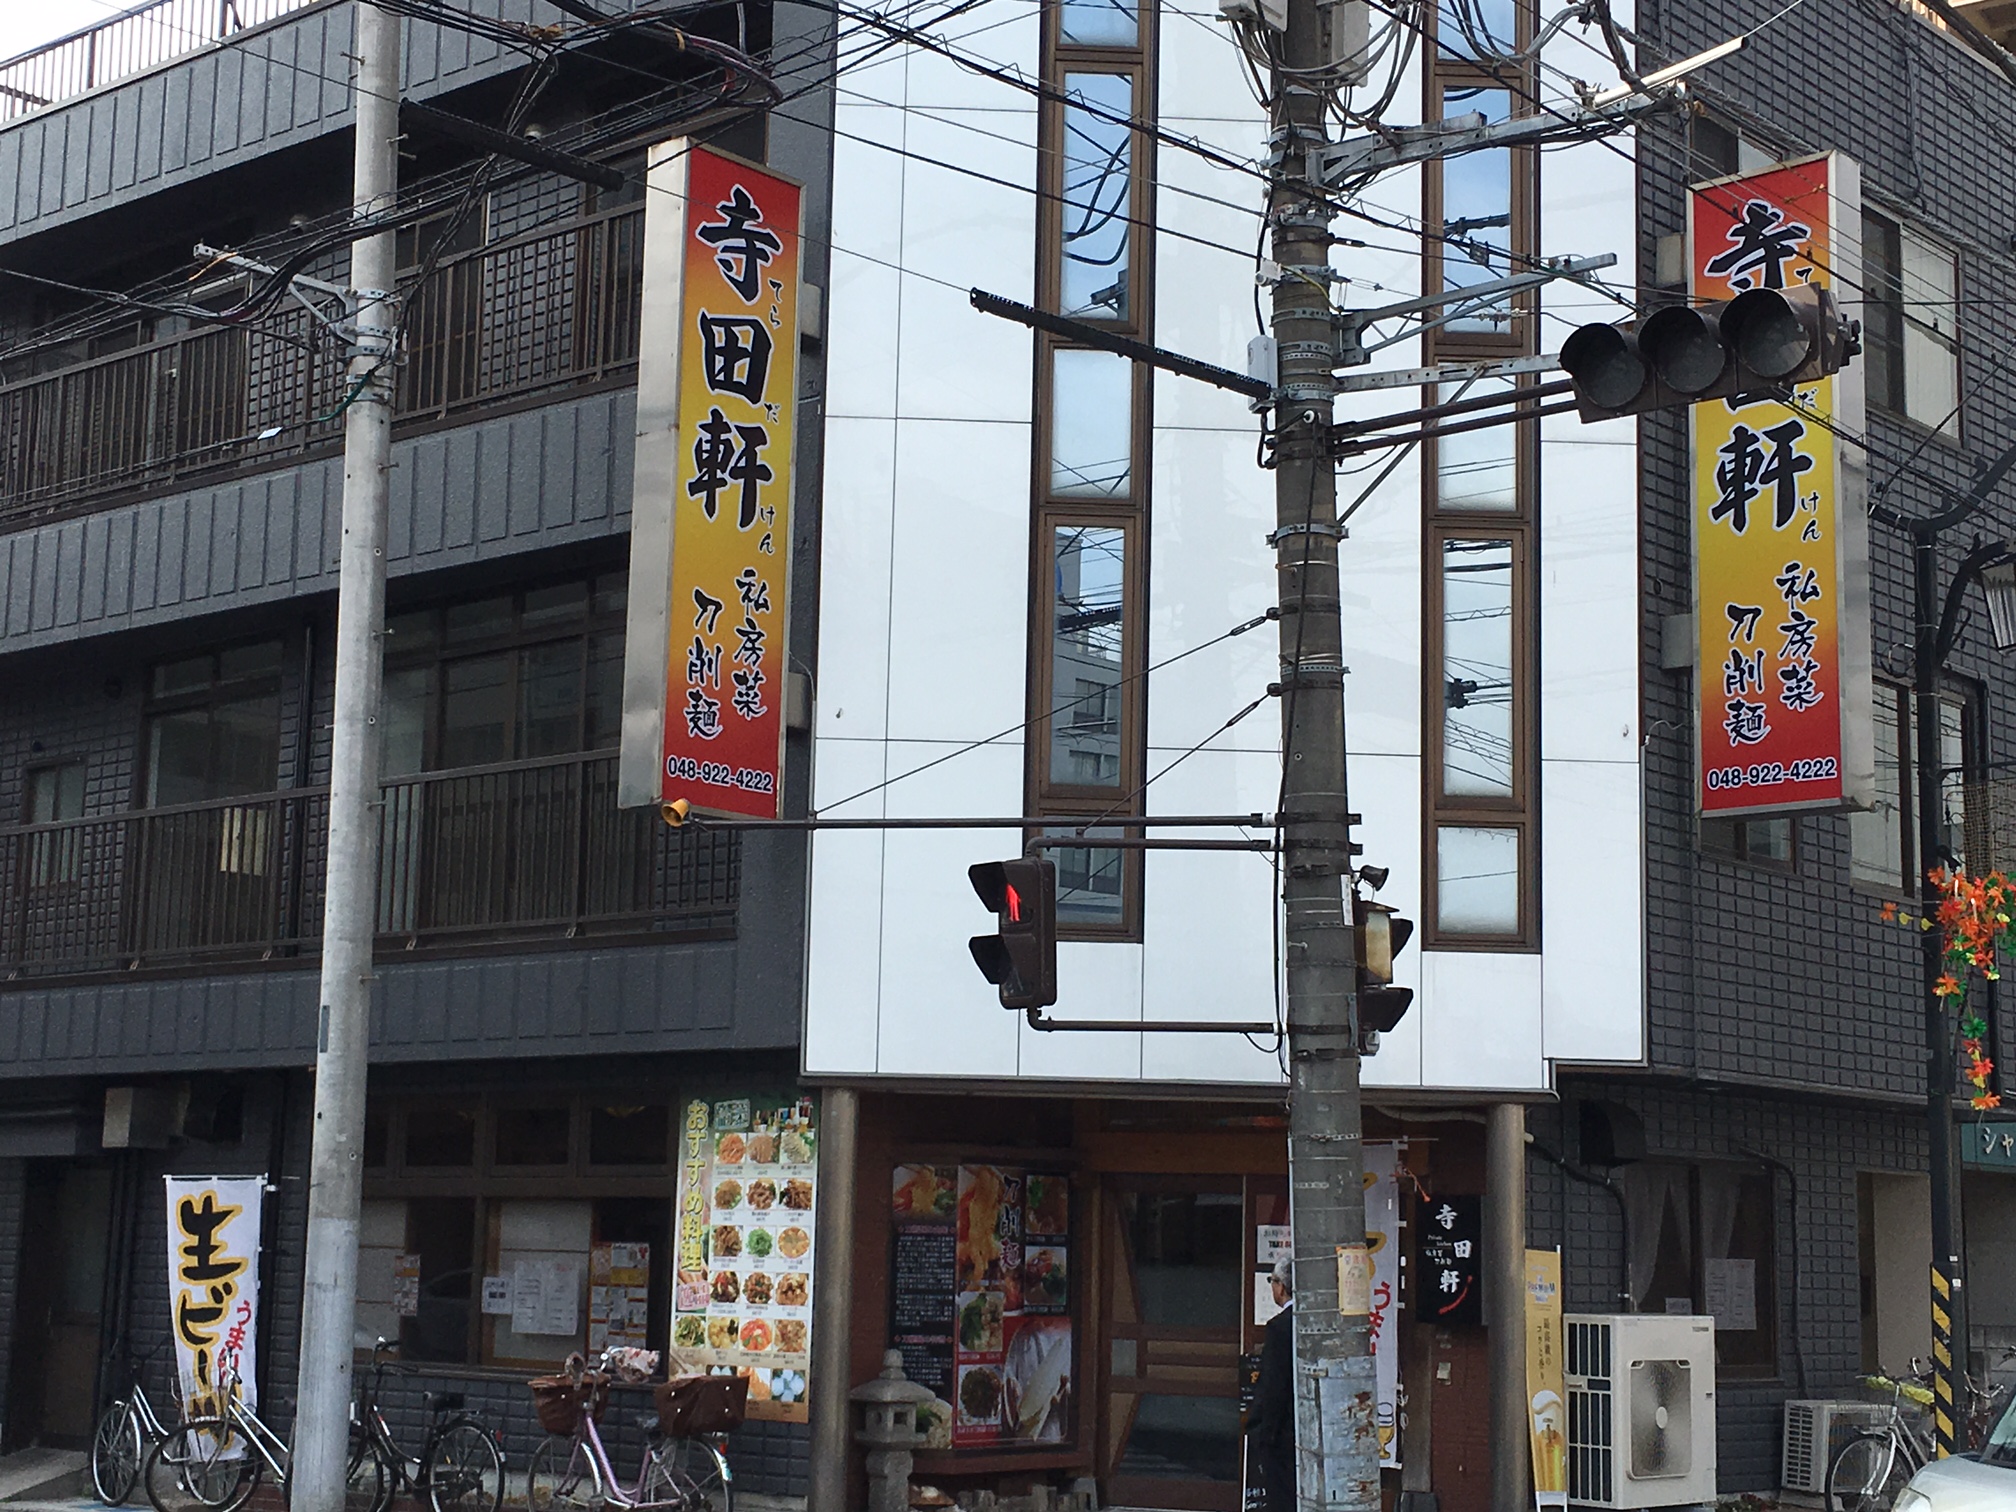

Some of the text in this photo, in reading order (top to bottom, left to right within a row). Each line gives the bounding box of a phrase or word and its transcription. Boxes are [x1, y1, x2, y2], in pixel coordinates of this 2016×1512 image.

[687, 184, 782, 532] 寺田軒
[759, 279, 784, 555] てら だ けん
[1704, 199, 1813, 536] 寺軒
[1800, 491, 1821, 541] けん
[734, 567, 770, 719] 私房菜
[1775, 561, 1823, 712] 私房菜
[667, 756, 773, 793] 048-922-4222
[1707, 757, 1837, 790] 048-922-4222
[680, 1100, 709, 1272] おすすめ料理
[1434, 1203, 1473, 1294] 寺田軒
